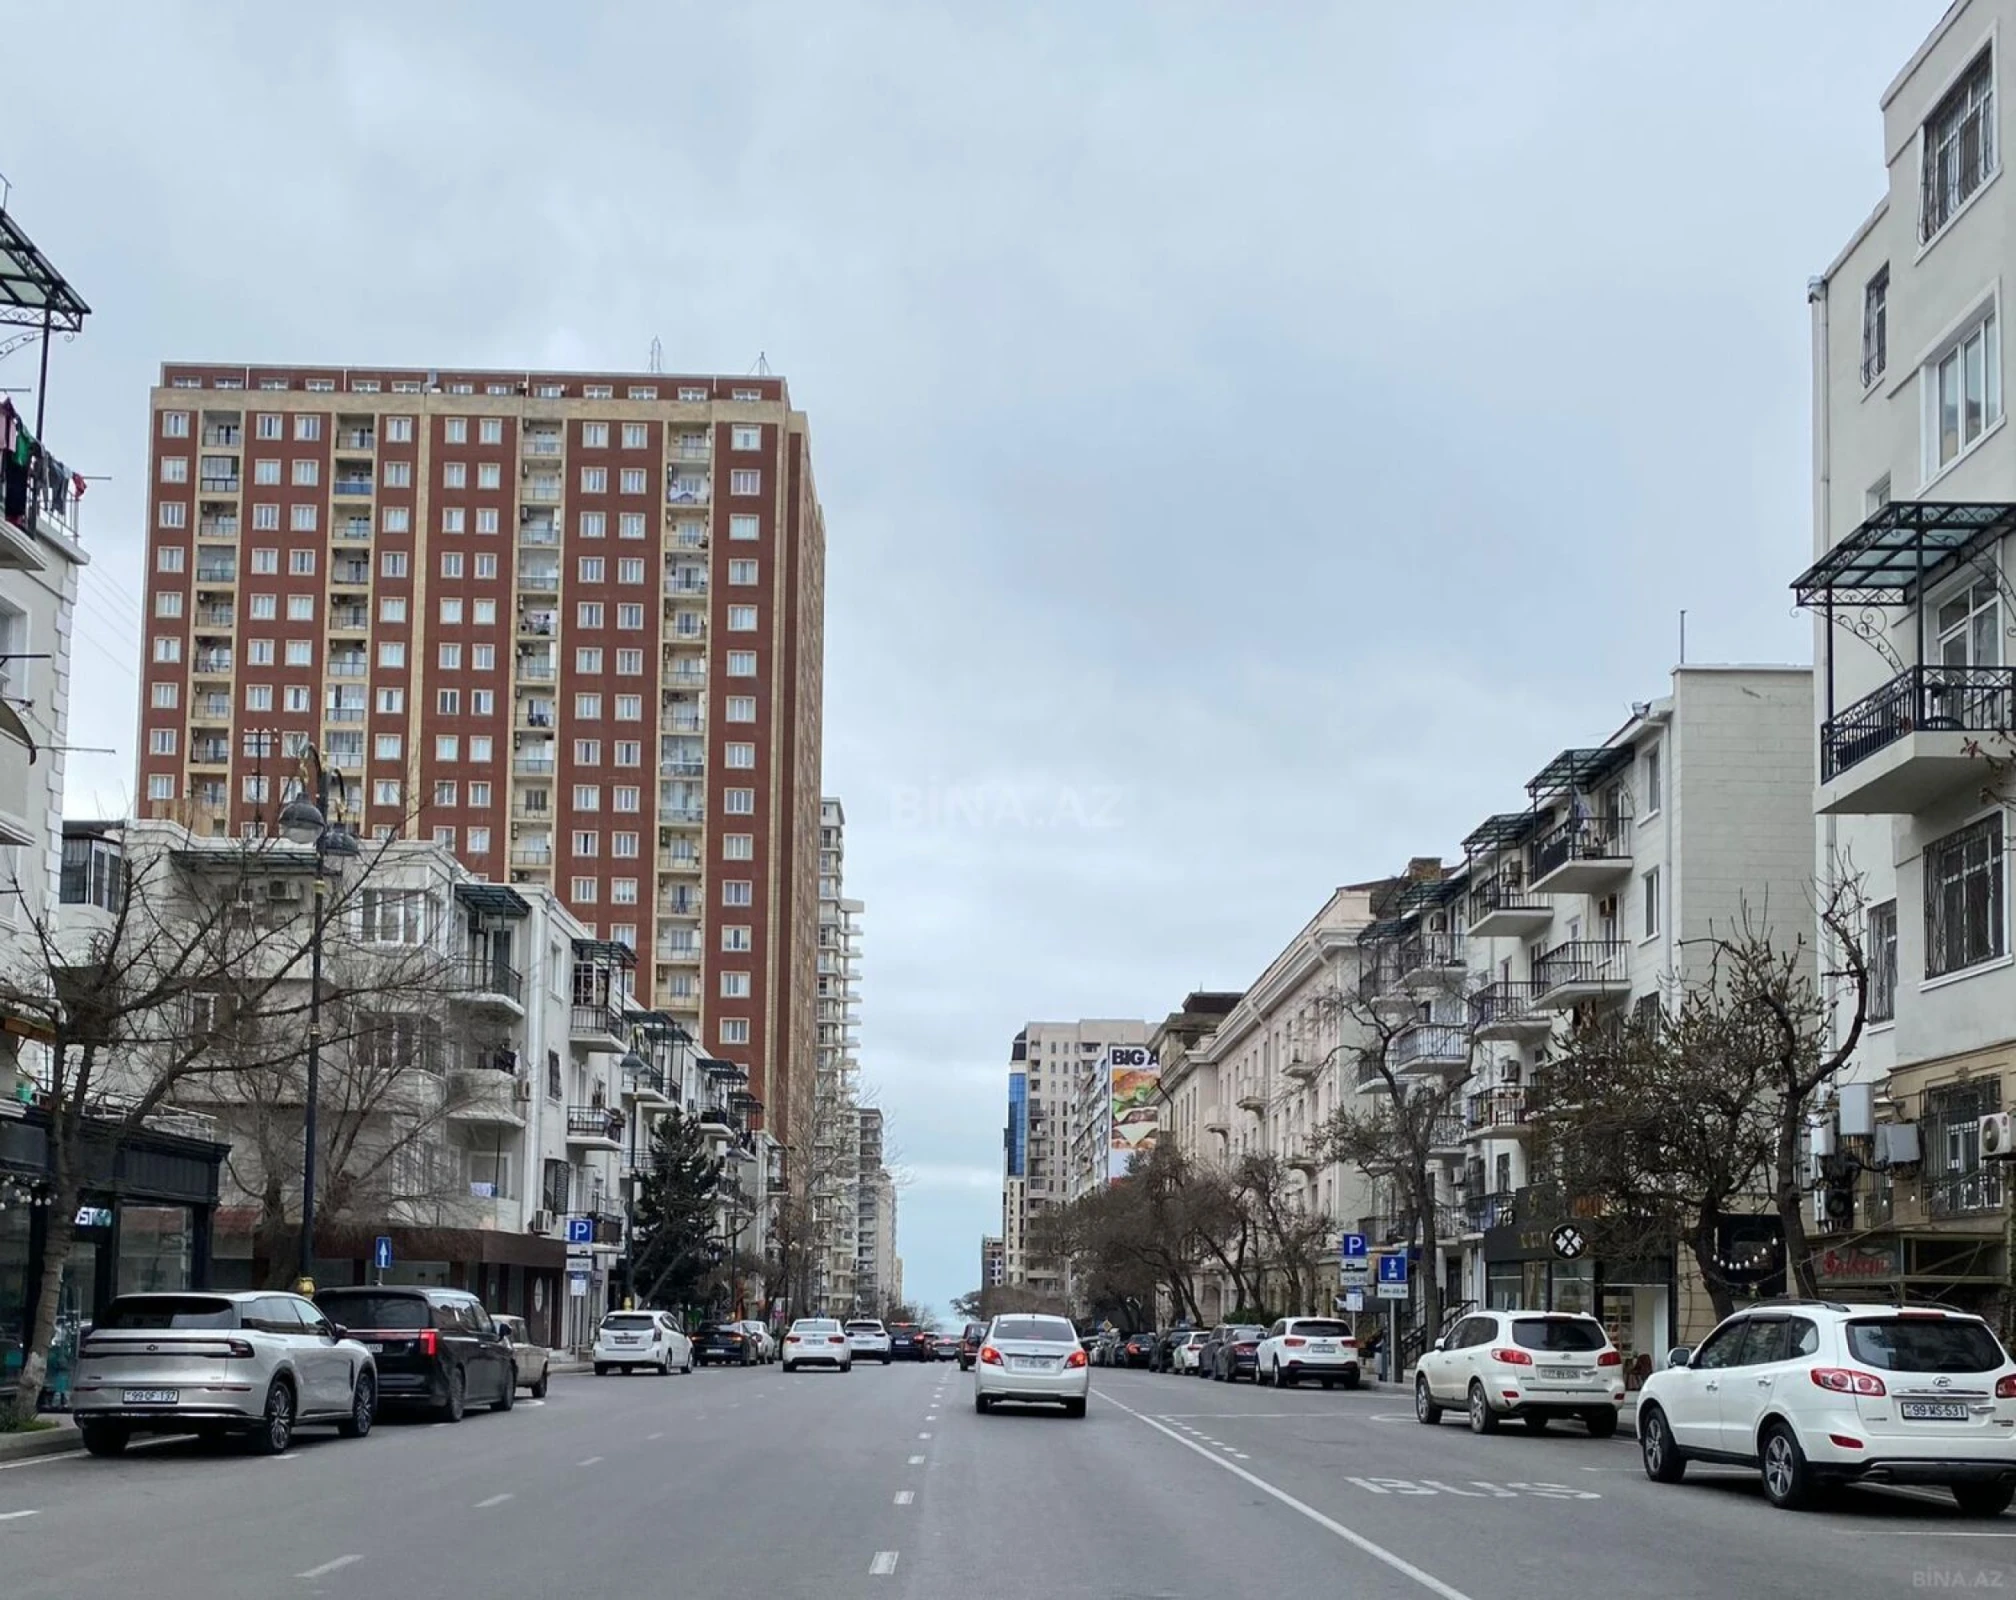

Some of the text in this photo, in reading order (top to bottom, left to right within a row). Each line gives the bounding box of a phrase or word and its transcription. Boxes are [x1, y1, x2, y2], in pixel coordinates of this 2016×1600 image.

[1112, 1049, 1145, 1065] BIG
[576, 1222, 588, 1240] P
[1349, 1236, 1363, 1254] P
[1344, 1476, 1601, 1499] BUS
